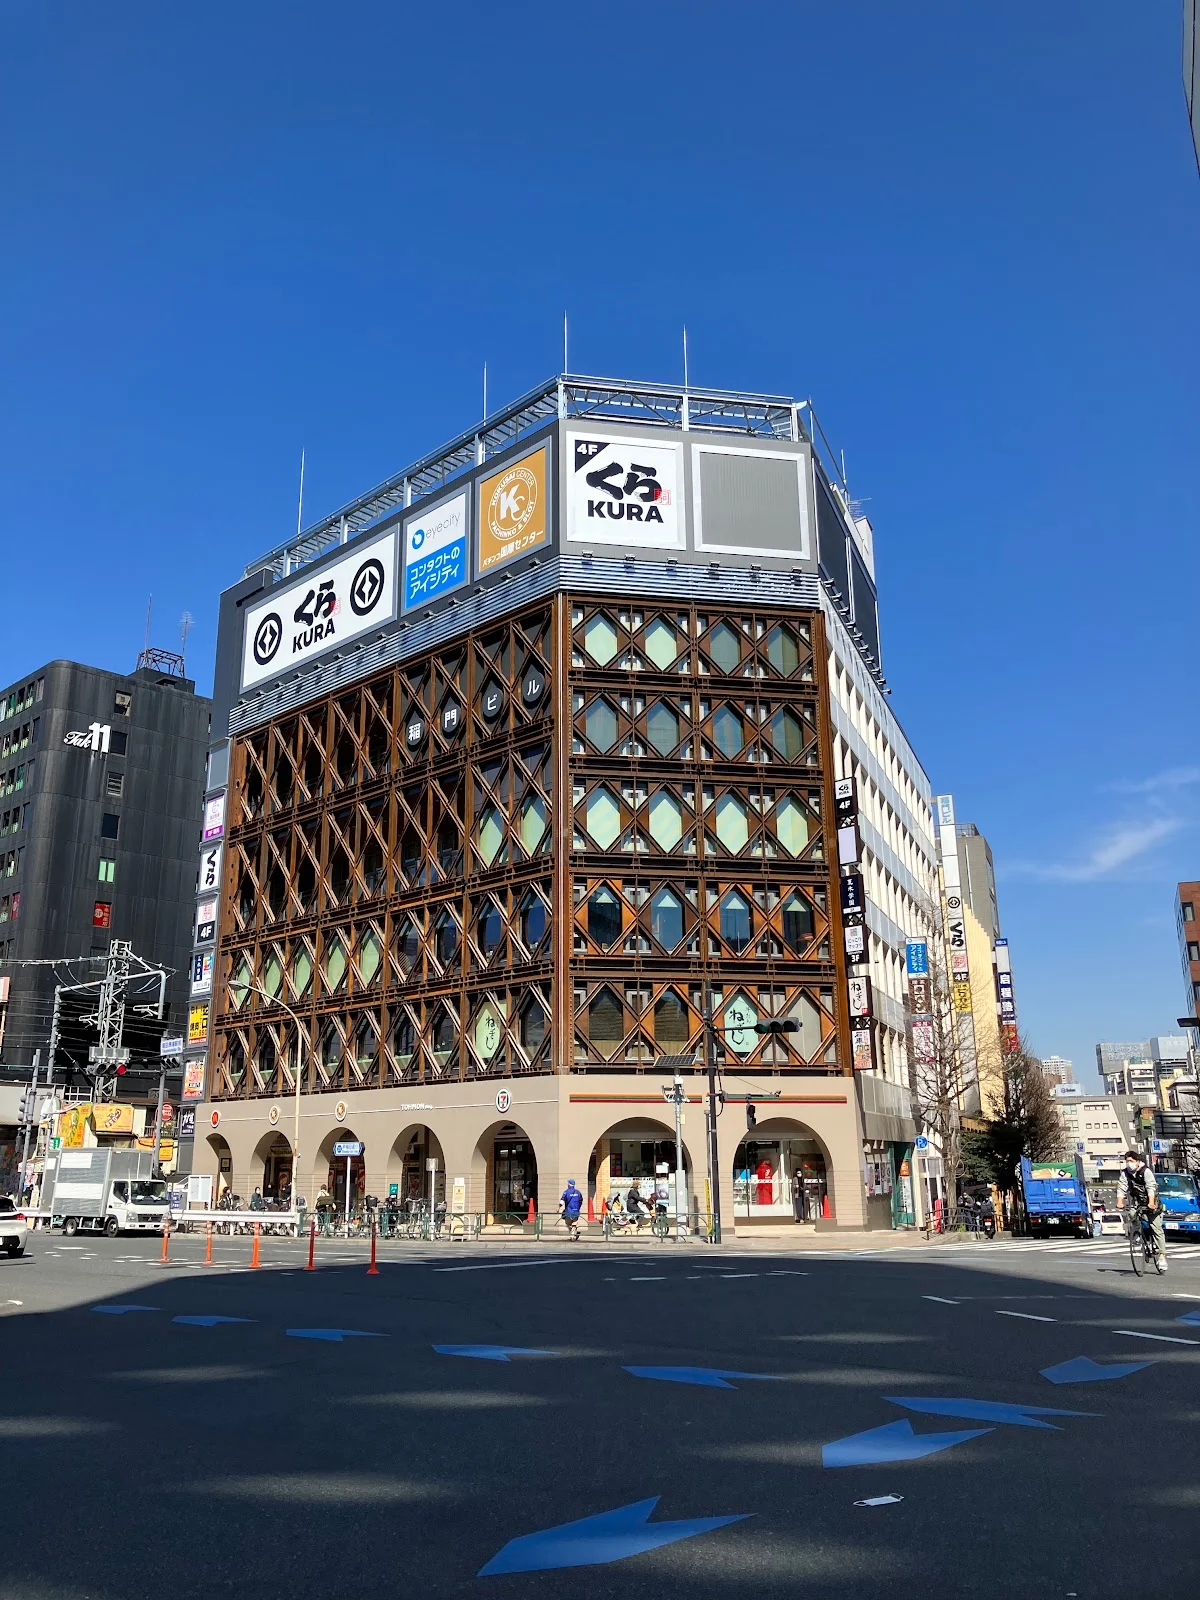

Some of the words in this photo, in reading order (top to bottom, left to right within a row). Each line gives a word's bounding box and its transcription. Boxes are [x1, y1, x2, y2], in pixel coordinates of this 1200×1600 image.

[577, 443, 599, 455] 4F
[491, 472, 516, 506] KOKUSAI
[516, 469, 535, 488] CENTER
[586, 461, 662, 502] くら
[425, 511, 461, 539] eyecity
[490, 521, 517, 539] PACHINKO
[522, 500, 535, 523] SLOT
[587, 499, 664, 523] KURA
[410, 546, 460, 581] コンタクトの
[410, 563, 459, 600] アイシティ
[293, 579, 336, 627] くら
[292, 617, 336, 654] KURA
[408, 679, 541, 742] 稲門ビル
[839, 800, 851, 809] 4F
[205, 849, 217, 886] くら
[200, 926, 212, 939] 4F
[851, 954, 860, 962] 3F
[955, 973, 967, 981] 4F
[851, 981, 862, 1010] ねぎし
[485, 1016, 496, 1051] ねぎし
